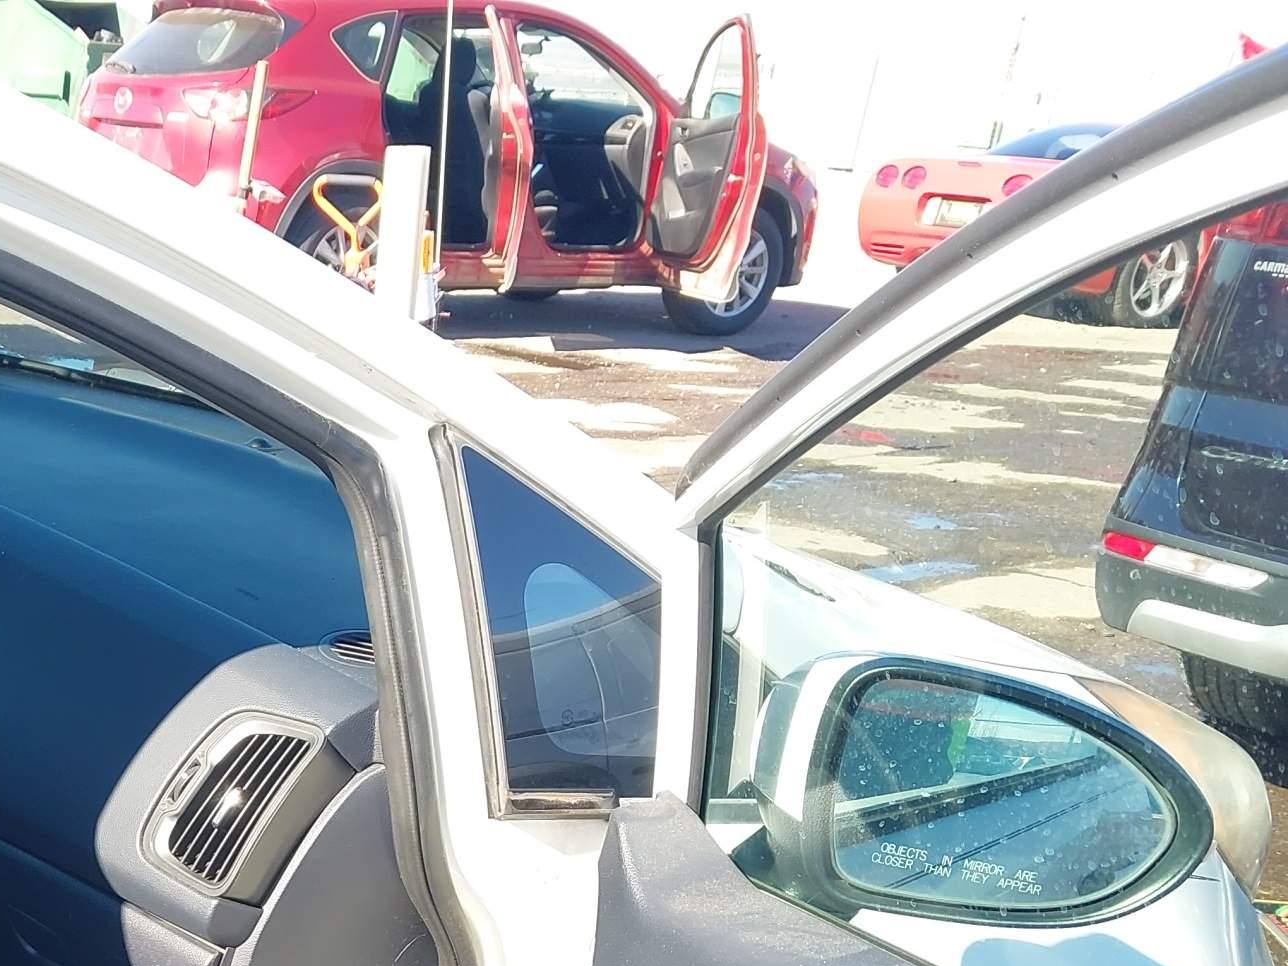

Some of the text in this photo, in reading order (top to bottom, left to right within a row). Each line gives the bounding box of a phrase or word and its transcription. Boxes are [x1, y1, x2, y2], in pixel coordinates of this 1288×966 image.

[871, 852, 1043, 896] CLOSER THAN THEY APPEAR
[880, 842, 1039, 883] OBJECTS IN MIRROR ARE
